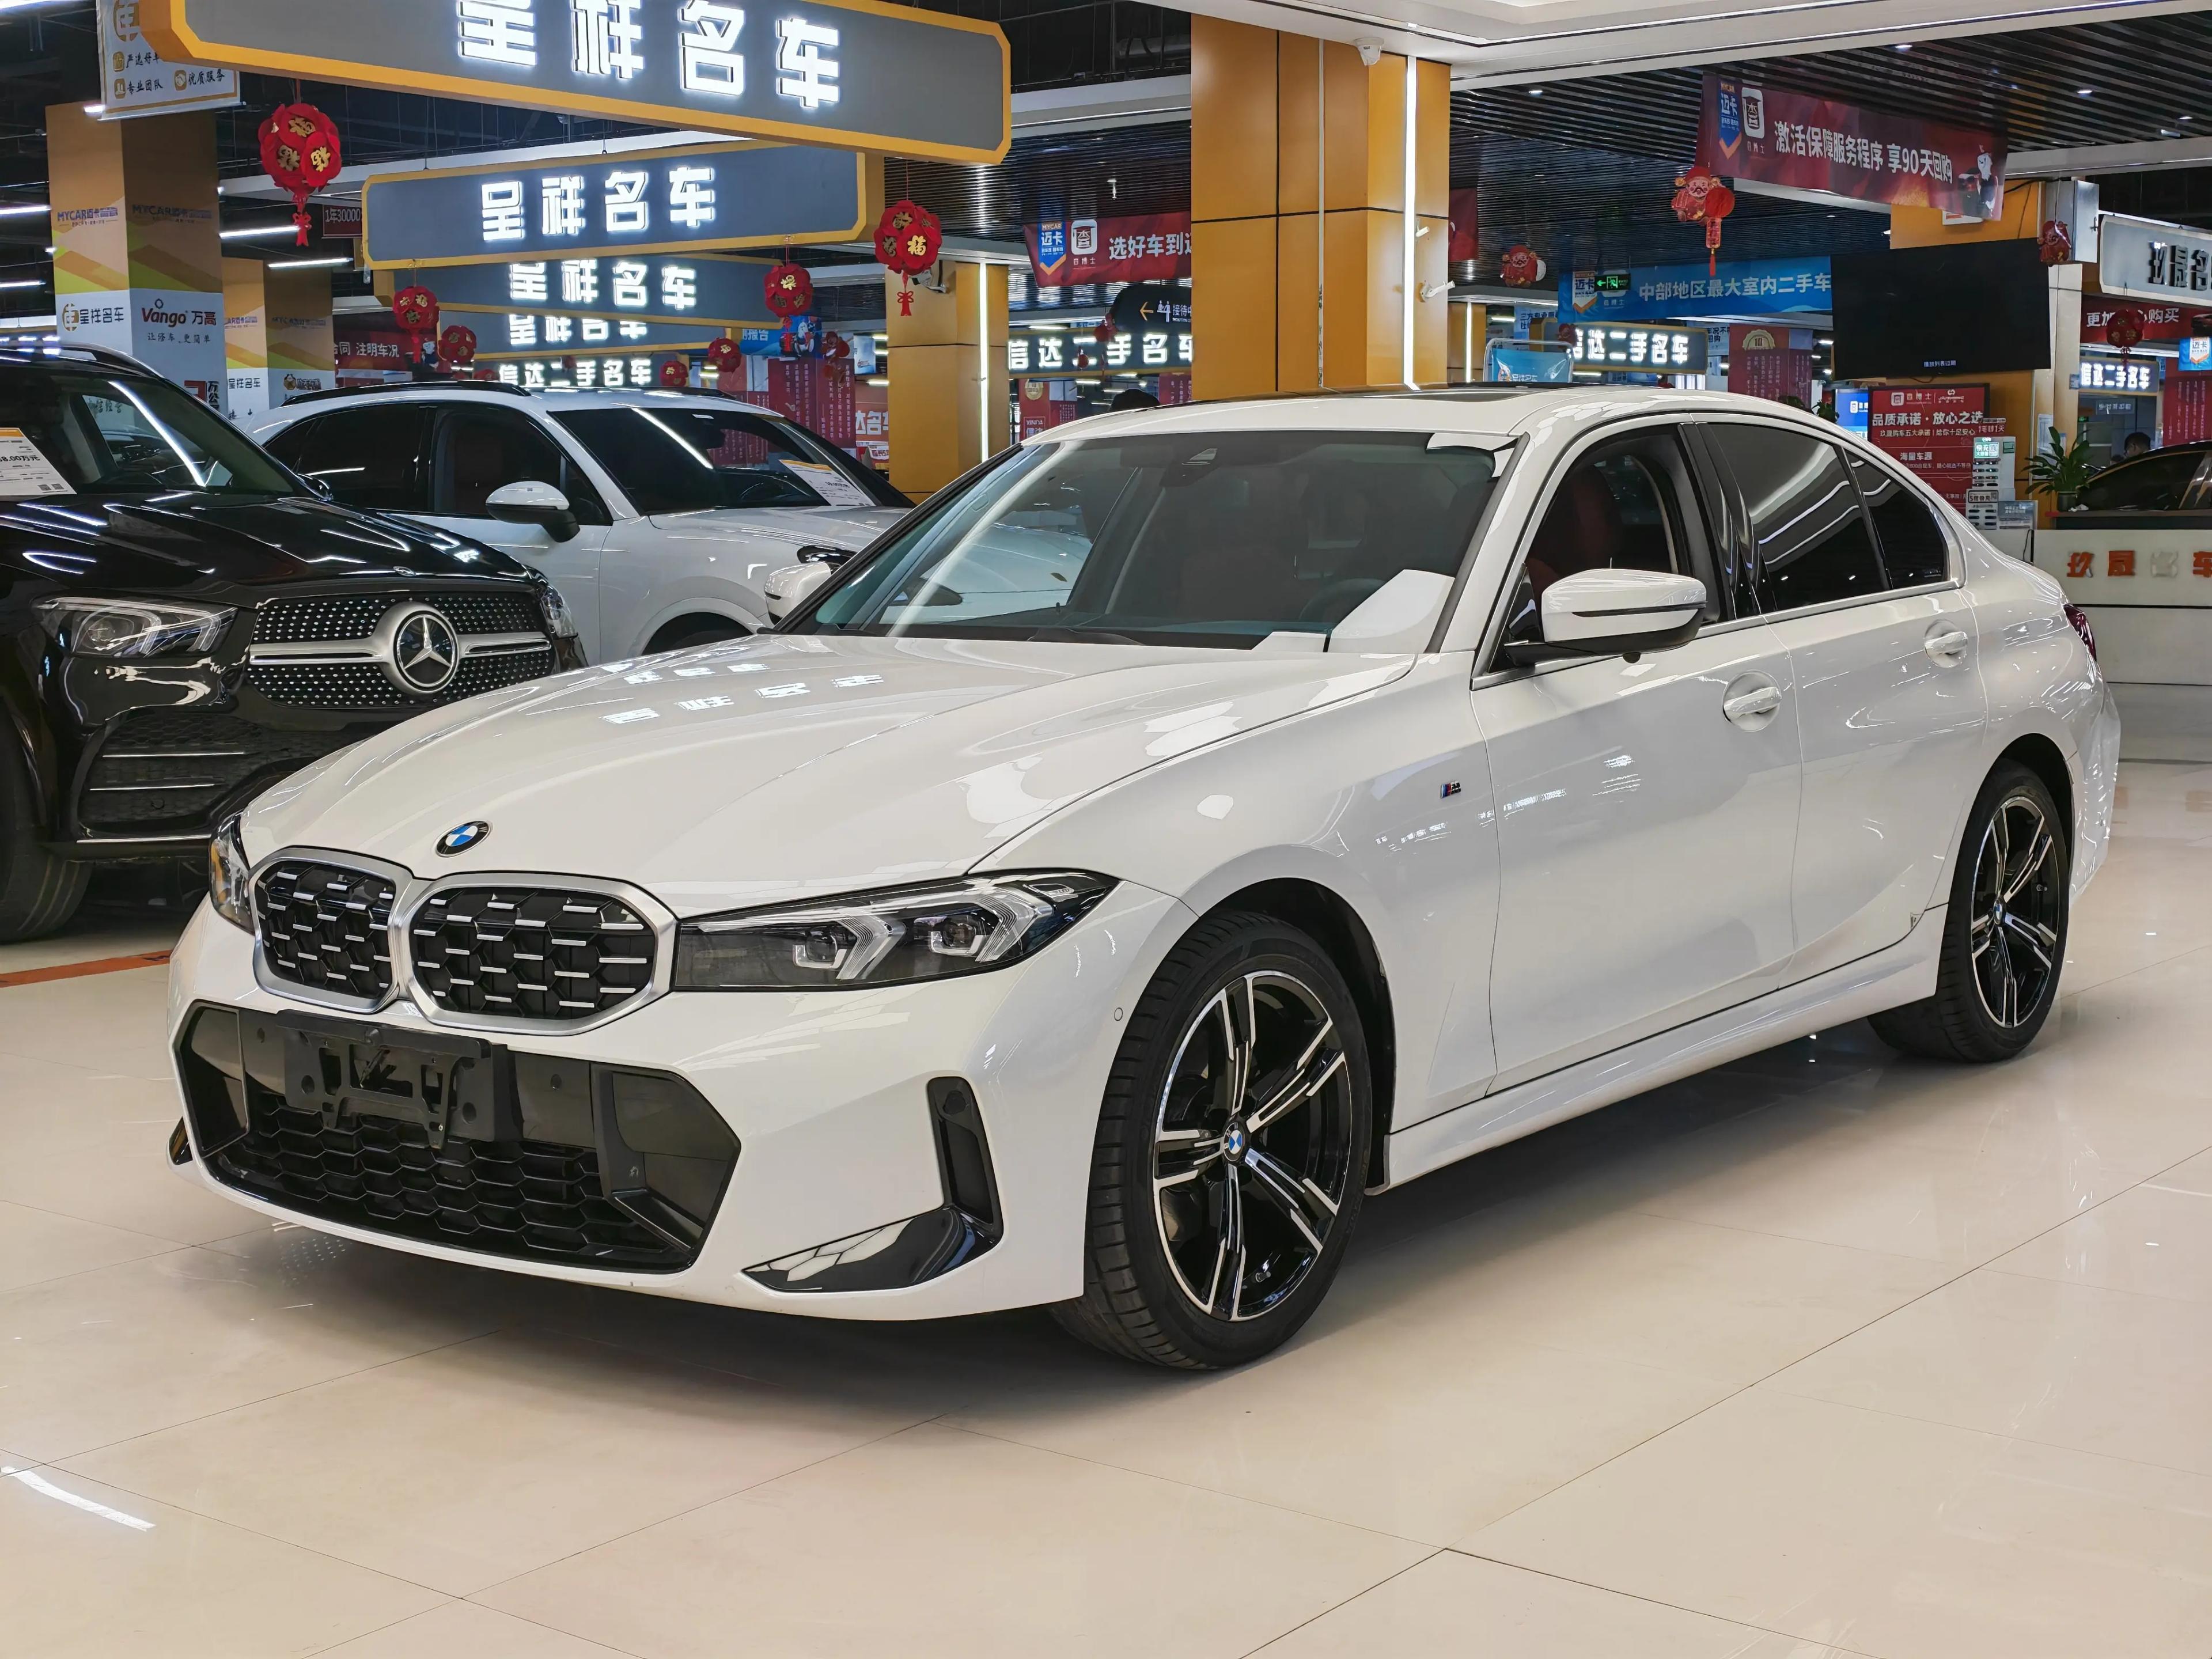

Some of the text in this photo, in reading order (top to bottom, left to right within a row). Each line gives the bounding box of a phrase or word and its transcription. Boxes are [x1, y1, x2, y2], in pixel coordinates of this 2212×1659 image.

[459, 0, 840, 108] 呈祥名车
[127, 79, 163, 94] 专业团队
[188, 70, 225, 85] 优质服务
[1721, 93, 1737, 116] 迈卡
[1774, 121, 1953, 184] 激活保障服务程序 享90天回购
[481, 165, 715, 241] 呈祥名车
[325, 208, 361, 223] 1年30000
[907, 235, 926, 256] 福
[1041, 231, 1063, 246] 迈卡
[509, 259, 696, 310] 呈祥名车
[1639, 272, 1832, 302] 中部地区最大室内二手车
[80, 307, 124, 324] 呈祥名车
[142, 308, 187, 327] Vango
[191, 311, 217, 326] 万高
[2086, 308, 2179, 327] 更加购买
[355, 342, 399, 358] 注明车况
[2192, 340, 2207, 349] 迈卡
[499, 358, 652, 387] 信达二手名车
[2081, 362, 2150, 390] 信达二手名车
[229, 378, 260, 389] 呈祥名车
